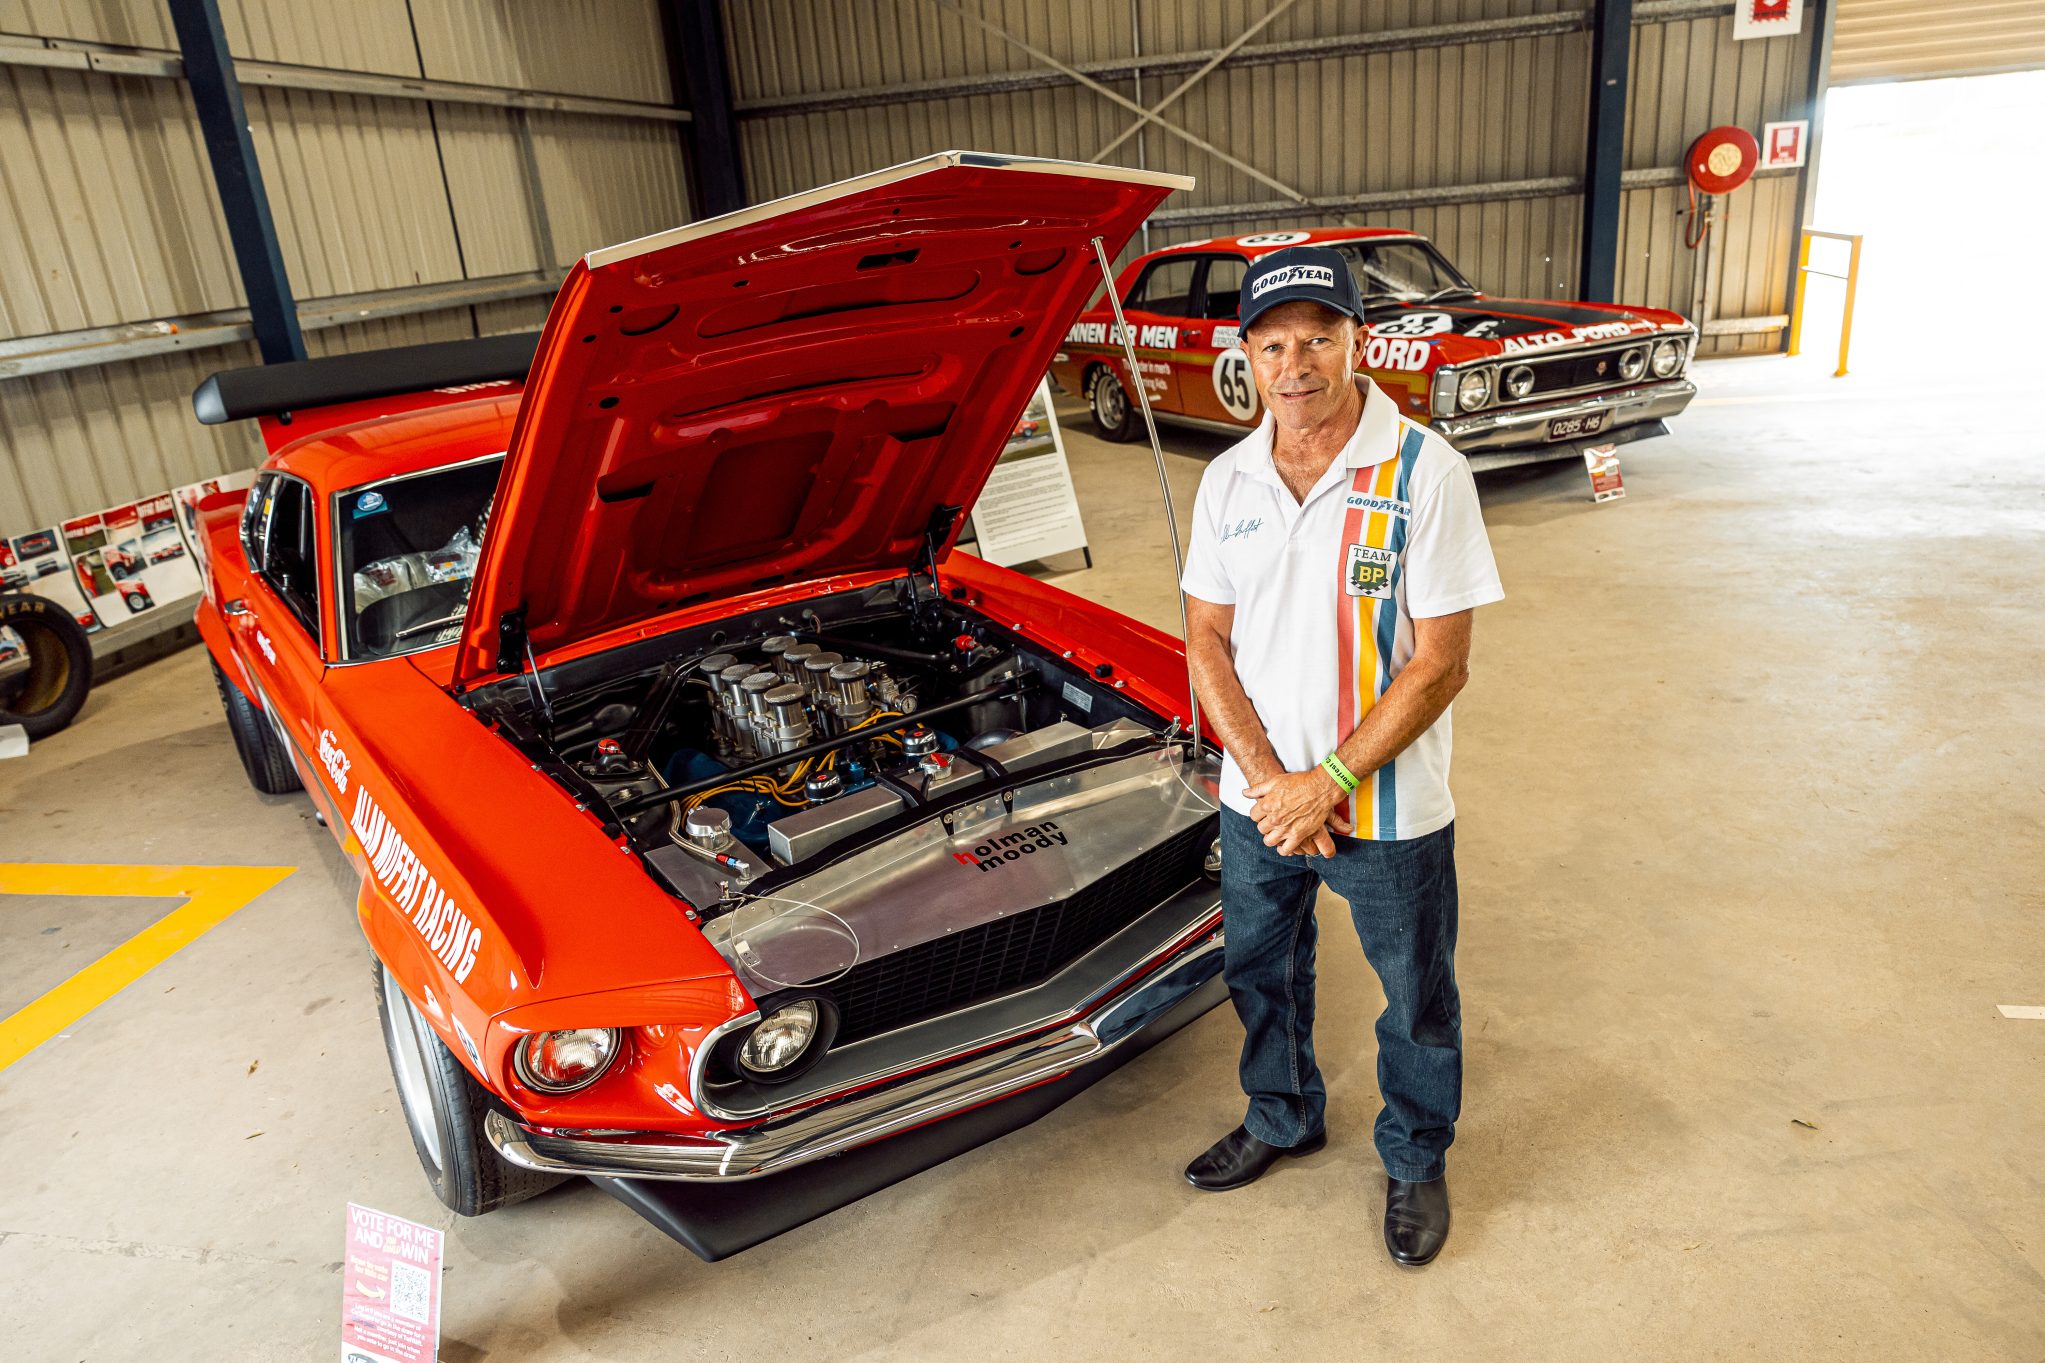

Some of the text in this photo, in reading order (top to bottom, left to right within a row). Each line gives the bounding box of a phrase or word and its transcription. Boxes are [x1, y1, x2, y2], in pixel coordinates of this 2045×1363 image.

[1140, 324, 1178, 349] MEN
[1364, 337, 1430, 372] ORD
[1503, 332, 1564, 353] ALTO
[1220, 358, 1250, 410] 65
[1354, 548, 1392, 562] TEAM
[1358, 566, 1384, 583] BP
[0, 602, 45, 618] EAR
[952, 822, 1058, 865] holman
[976, 832, 1068, 872] moody
[350, 784, 386, 858] ALLAN
[372, 820, 428, 914] MOFFAT
[412, 876, 482, 984] RACING
[351, 1207, 434, 1249] VOTE FOR ME
[354, 1227, 428, 1265] AND WIN
